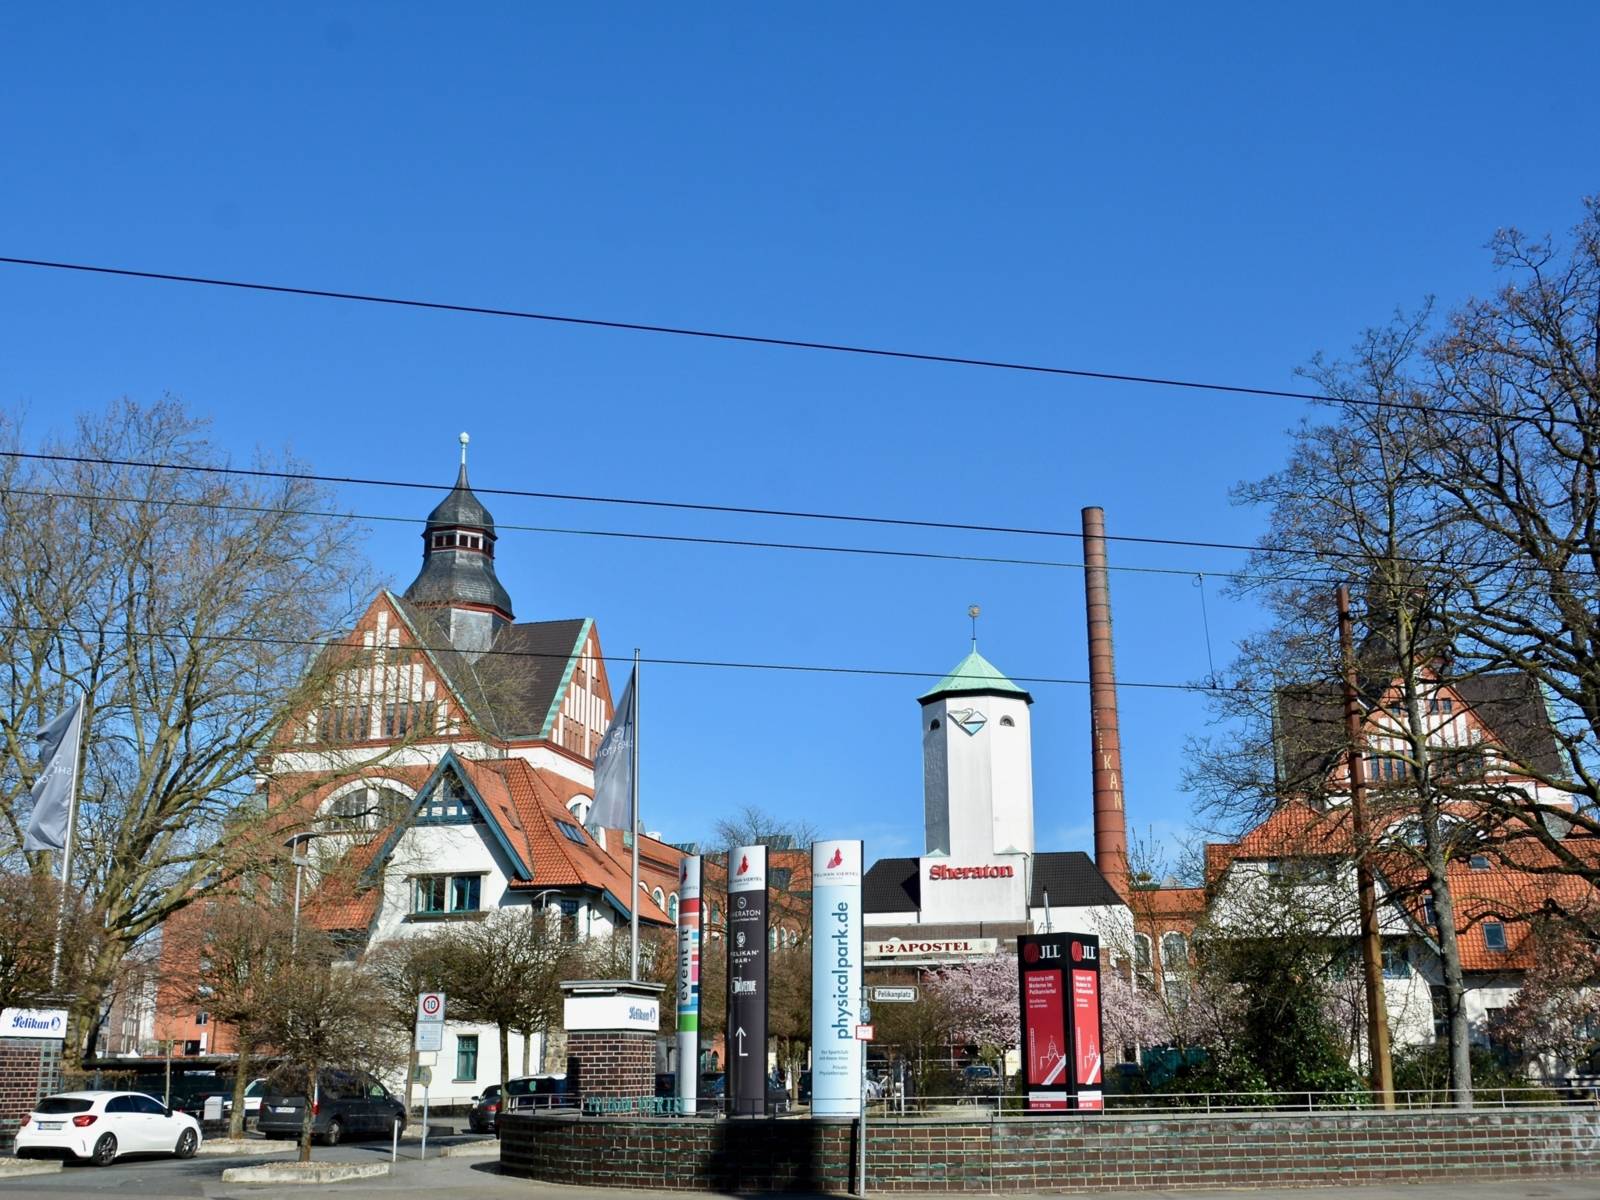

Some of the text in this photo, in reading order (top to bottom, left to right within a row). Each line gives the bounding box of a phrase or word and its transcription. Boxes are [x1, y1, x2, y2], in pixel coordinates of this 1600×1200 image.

[929, 864, 1014, 881] Sheraton
[878, 941, 973, 953] 12 APOSTEL
[1040, 944, 1061, 959] JLL
[1082, 945, 1097, 960] JLL
[680, 928, 689, 1001] event it
[831, 901, 853, 1040] physicalpark.de
[877, 990, 912, 999] Pelikanplatz
[427, 1000, 436, 1010] 10
[12, 1015, 50, 1030] Pelikan
